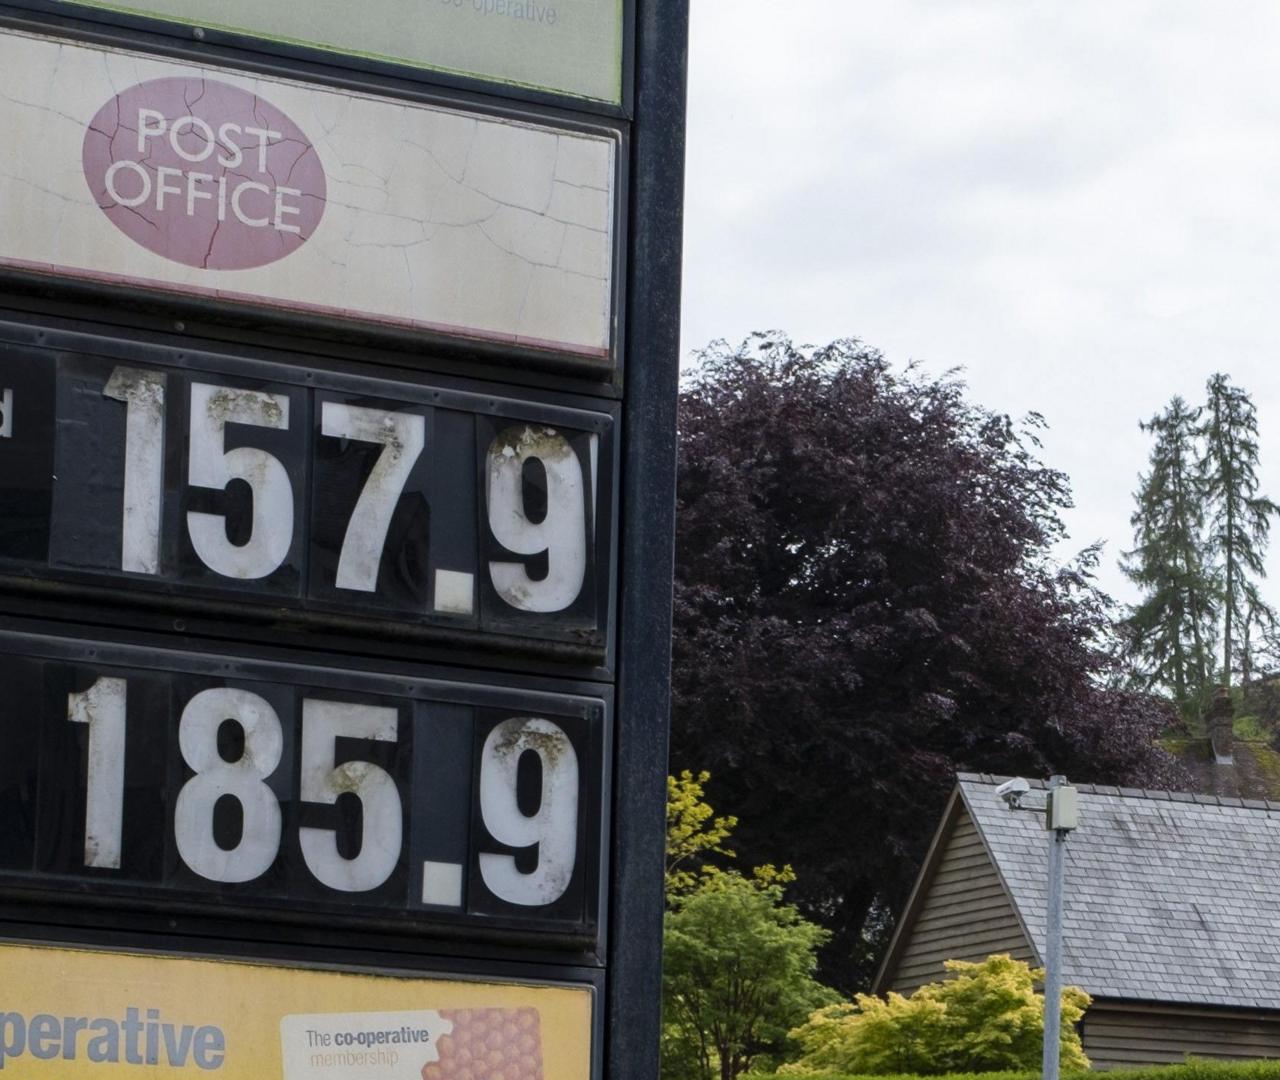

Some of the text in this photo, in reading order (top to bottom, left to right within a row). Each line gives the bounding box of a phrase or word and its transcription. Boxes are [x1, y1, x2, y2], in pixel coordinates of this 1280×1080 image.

[136, 108, 282, 173] POST
[105, 159, 302, 235] OFFICE
[104, 365, 587, 613] 157.9
[68, 676, 580, 906] 185.9
[306, 1027, 429, 1049] The co-operative
[310, 1049, 399, 1067] membership
